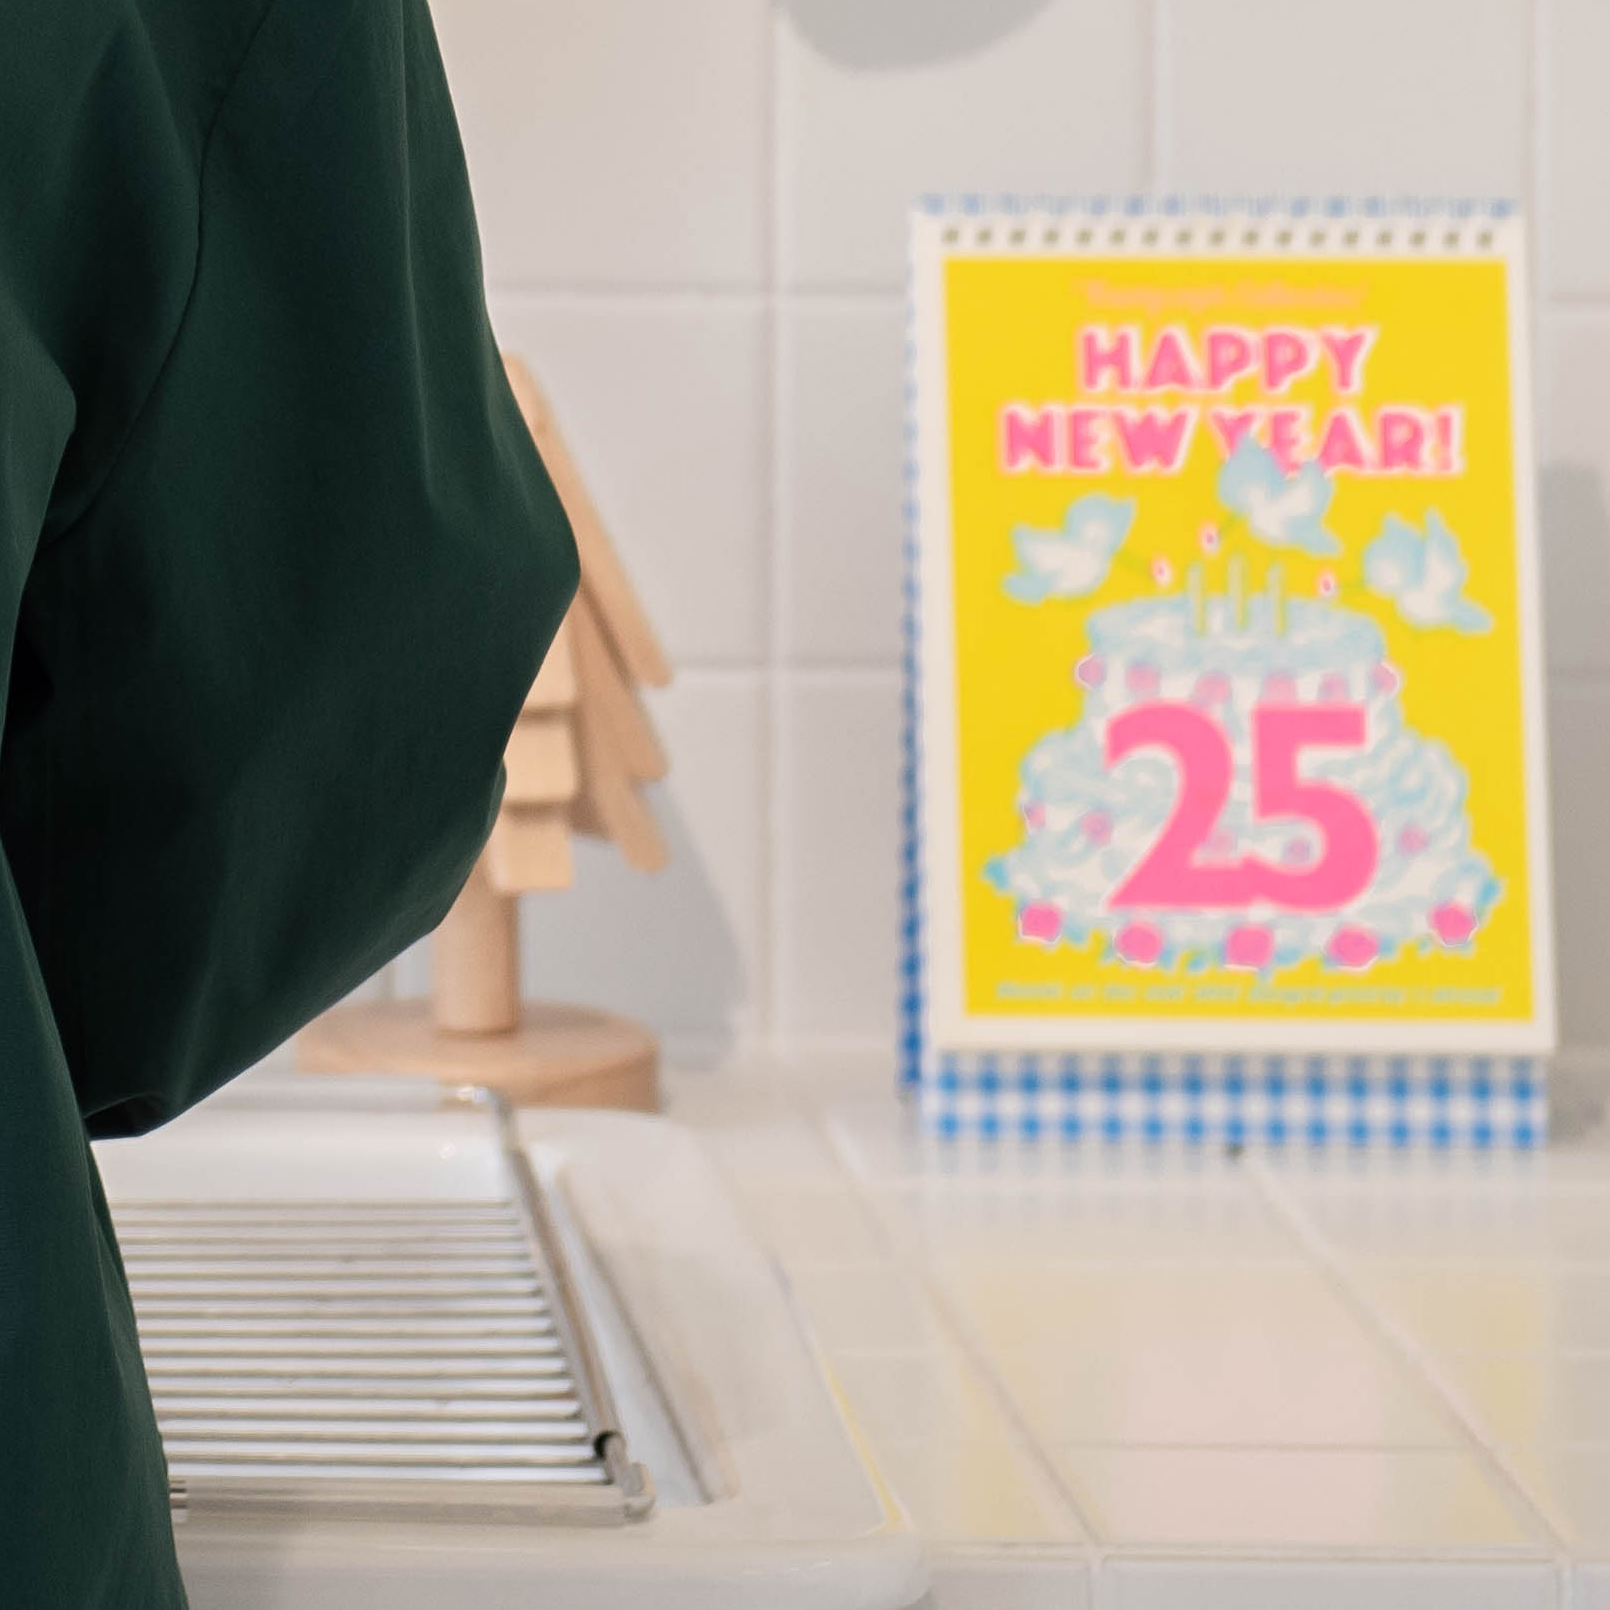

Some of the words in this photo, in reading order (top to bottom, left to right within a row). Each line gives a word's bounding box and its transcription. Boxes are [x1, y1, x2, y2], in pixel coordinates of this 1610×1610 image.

[1079, 328, 1370, 393] HAPPY
[1002, 408, 1188, 472] NEW
[1210, 408, 1460, 475] YEAR!
[1103, 700, 1381, 913] 25
